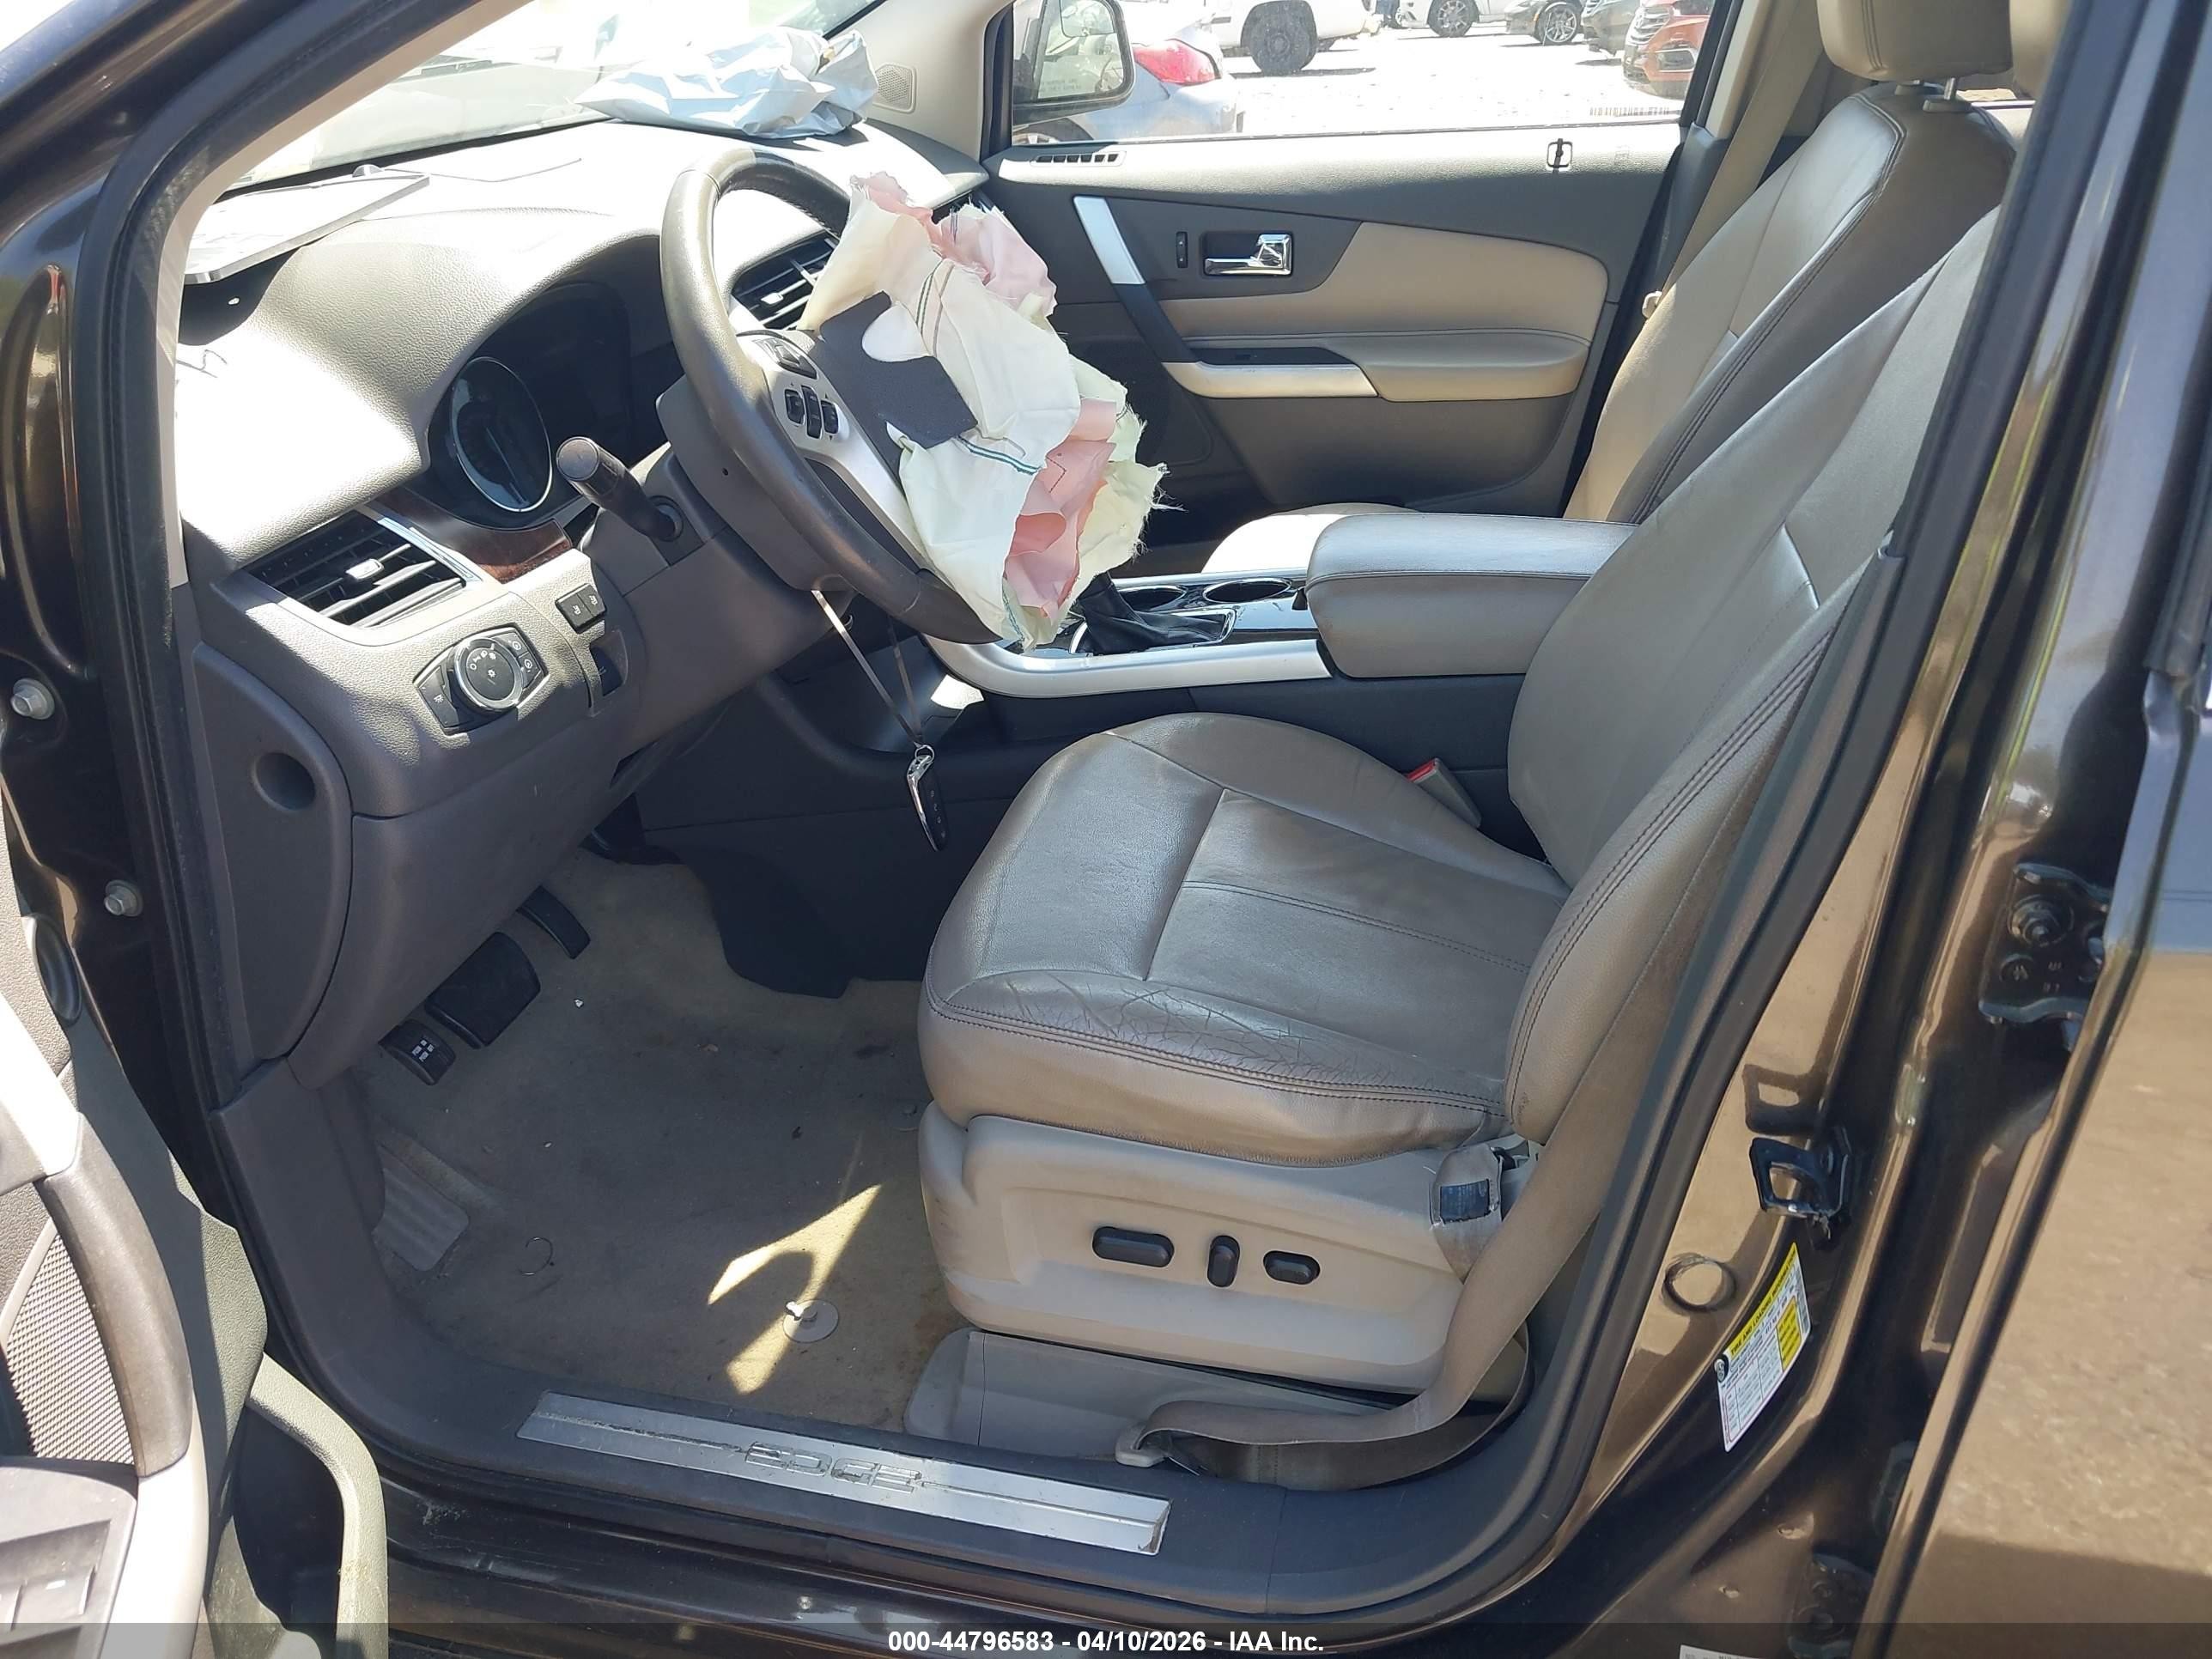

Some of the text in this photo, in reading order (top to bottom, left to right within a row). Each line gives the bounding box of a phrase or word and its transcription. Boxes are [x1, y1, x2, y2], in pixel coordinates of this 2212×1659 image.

[1730, 1340, 1742, 1355] TIRE
[1742, 1327, 1753, 1341] AND
[1752, 1296, 1772, 1326] LOADING
[745, 1441, 921, 1494] EDGE
